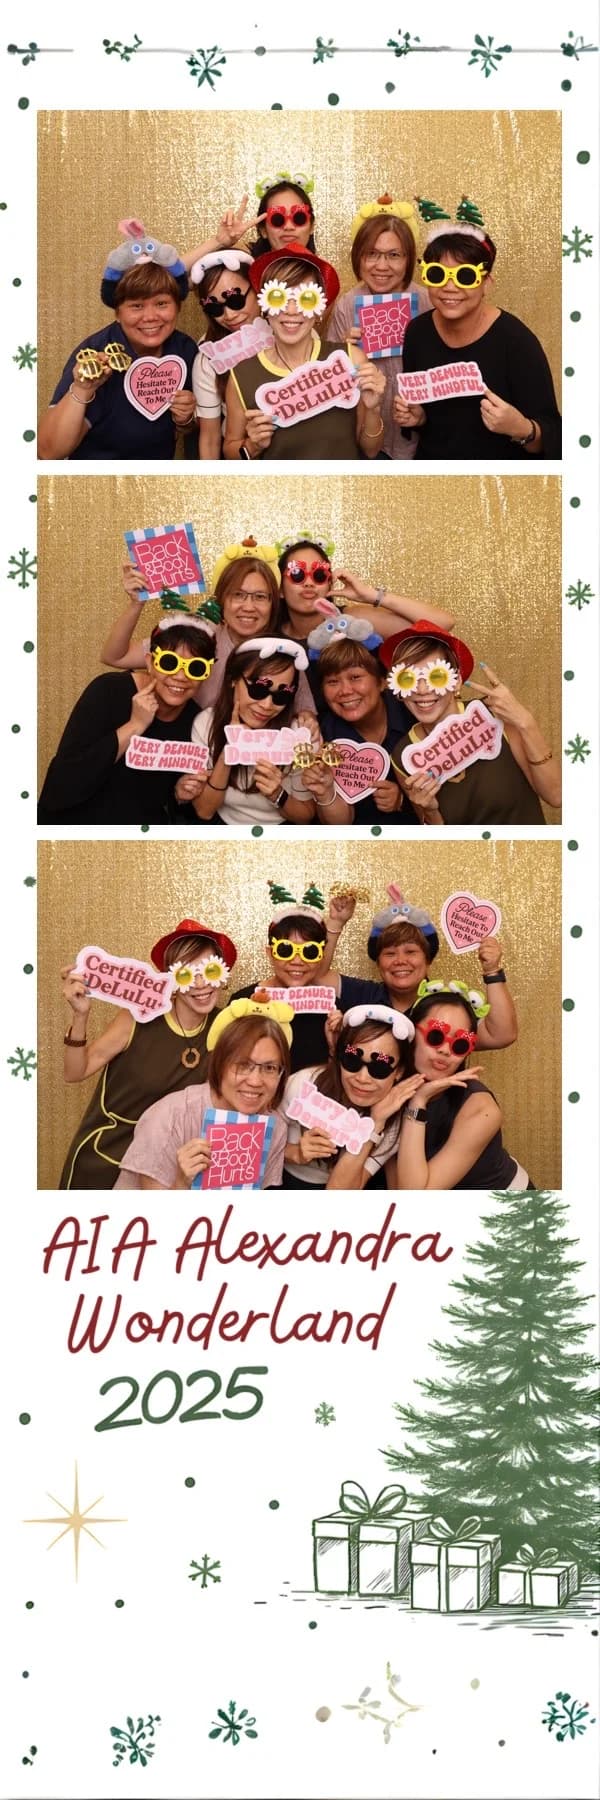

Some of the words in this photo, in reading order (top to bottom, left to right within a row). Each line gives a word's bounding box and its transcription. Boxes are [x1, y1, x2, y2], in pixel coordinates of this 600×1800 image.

[361, 302, 409, 328] Back
[138, 367, 173, 380] Please
[265, 360, 347, 405] Certified
[399, 374, 427, 388] VERY
[429, 364, 479, 384] DEMURE
[136, 380, 167, 389] Hesitate
[137, 388, 160, 396] Reach
[400, 388, 429, 401] VERY
[432, 379, 484, 397] MINDFUL
[278, 378, 353, 419] DeLuLu
[135, 535, 190, 565] Back
[149, 568, 195, 590] Hurts
[227, 727, 278, 747] Very
[411, 710, 485, 768] Certified
[133, 738, 160, 753] VERY
[164, 743, 208, 760] DEMURE
[227, 746, 294, 764] Demur
[340, 750, 374, 763] Please
[427, 729, 493, 779] DeLuLu
[128, 752, 155, 767] VERY
[158, 757, 206, 771] MINDFUL
[369, 766, 378, 774] To
[335, 770, 359, 779] Reach
[451, 912, 479, 928] Hesitate
[480, 924, 488, 932] To
[455, 903, 488, 922] Please
[450, 920, 470, 934] Reach
[454, 930, 462, 938] To
[463, 934, 474, 943] Me
[85, 955, 168, 994] Certified
[87, 973, 158, 1009] DeLuLu
[289, 987, 334, 999] DEMURE
[293, 1000, 335, 1011] INDFUL
[301, 1082, 346, 1120] Very
[210, 1126, 262, 1152] Back
[207, 1166, 255, 1187] Hurts
